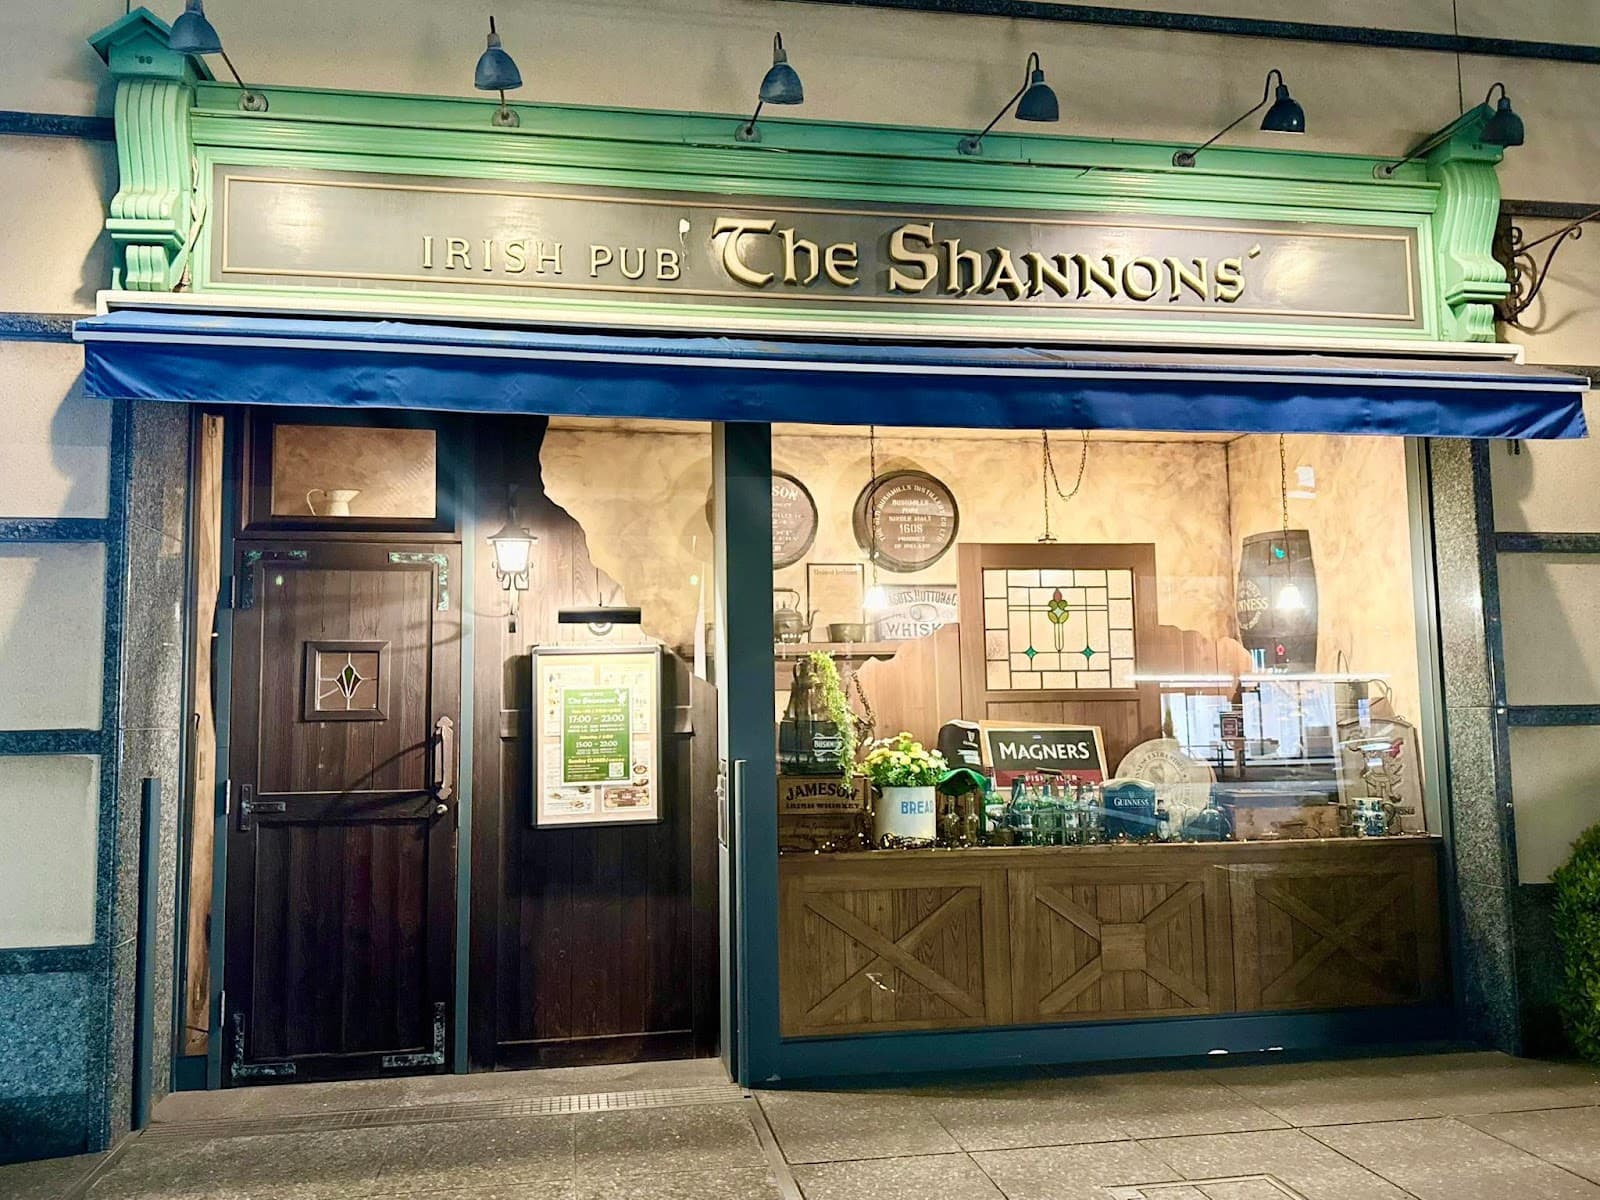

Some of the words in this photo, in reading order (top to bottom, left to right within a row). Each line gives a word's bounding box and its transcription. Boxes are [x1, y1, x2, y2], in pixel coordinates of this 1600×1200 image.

[421, 235, 563, 274] IRISH
[589, 243, 682, 281] PUB
[711, 216, 860, 288] The
[568, 714, 591, 723] 17:00
[998, 741, 1090, 761] MAGNERS
[786, 782, 860, 801] JAMESON
[1113, 797, 1150, 807] GUINNESS
